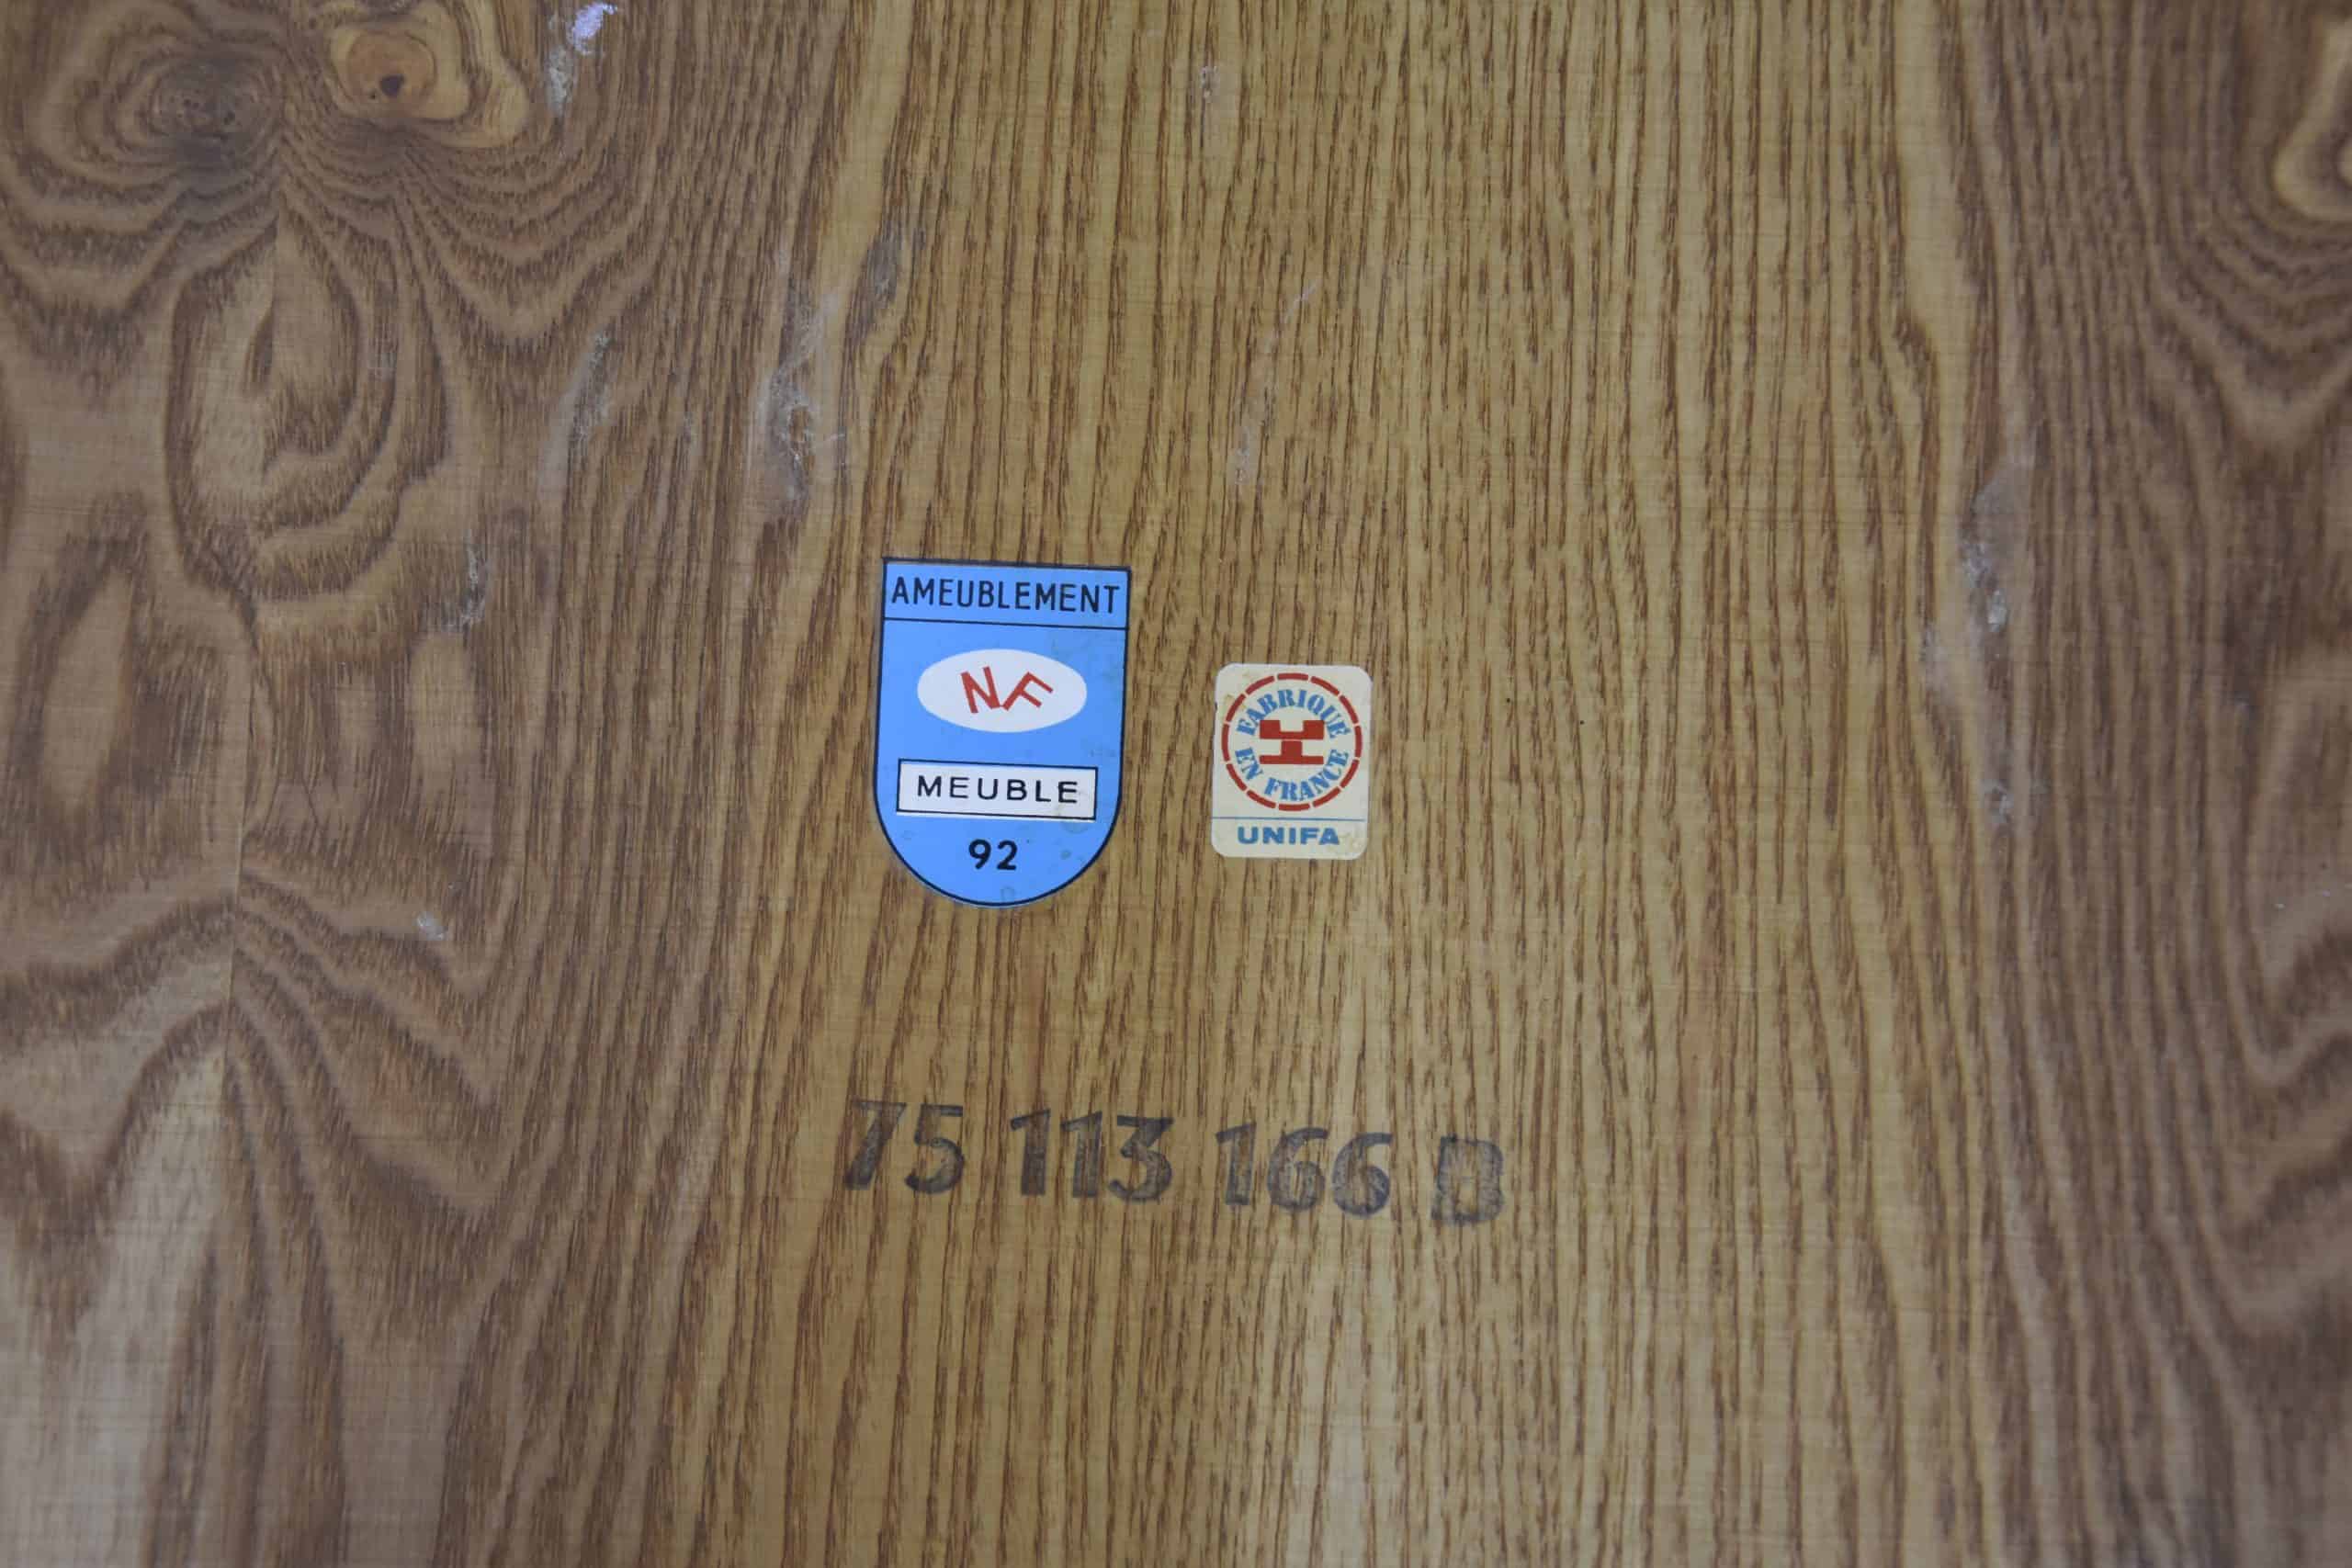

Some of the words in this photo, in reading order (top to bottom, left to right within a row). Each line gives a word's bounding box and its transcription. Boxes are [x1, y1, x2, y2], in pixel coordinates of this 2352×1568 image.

[891, 575, 1120, 614] AMEUBLEMENT
[960, 665, 1054, 714] NF
[917, 774, 1078, 804] MEUBLE
[1235, 747, 1263, 781] EN
[1263, 749, 1349, 801] FRANCE
[967, 838, 1018, 871] 92
[1237, 826, 1340, 845] UNIFA
[843, 1099, 965, 1194] 75
[1010, 1108, 1174, 1203] 113
[1215, 1120, 1393, 1218] 166
